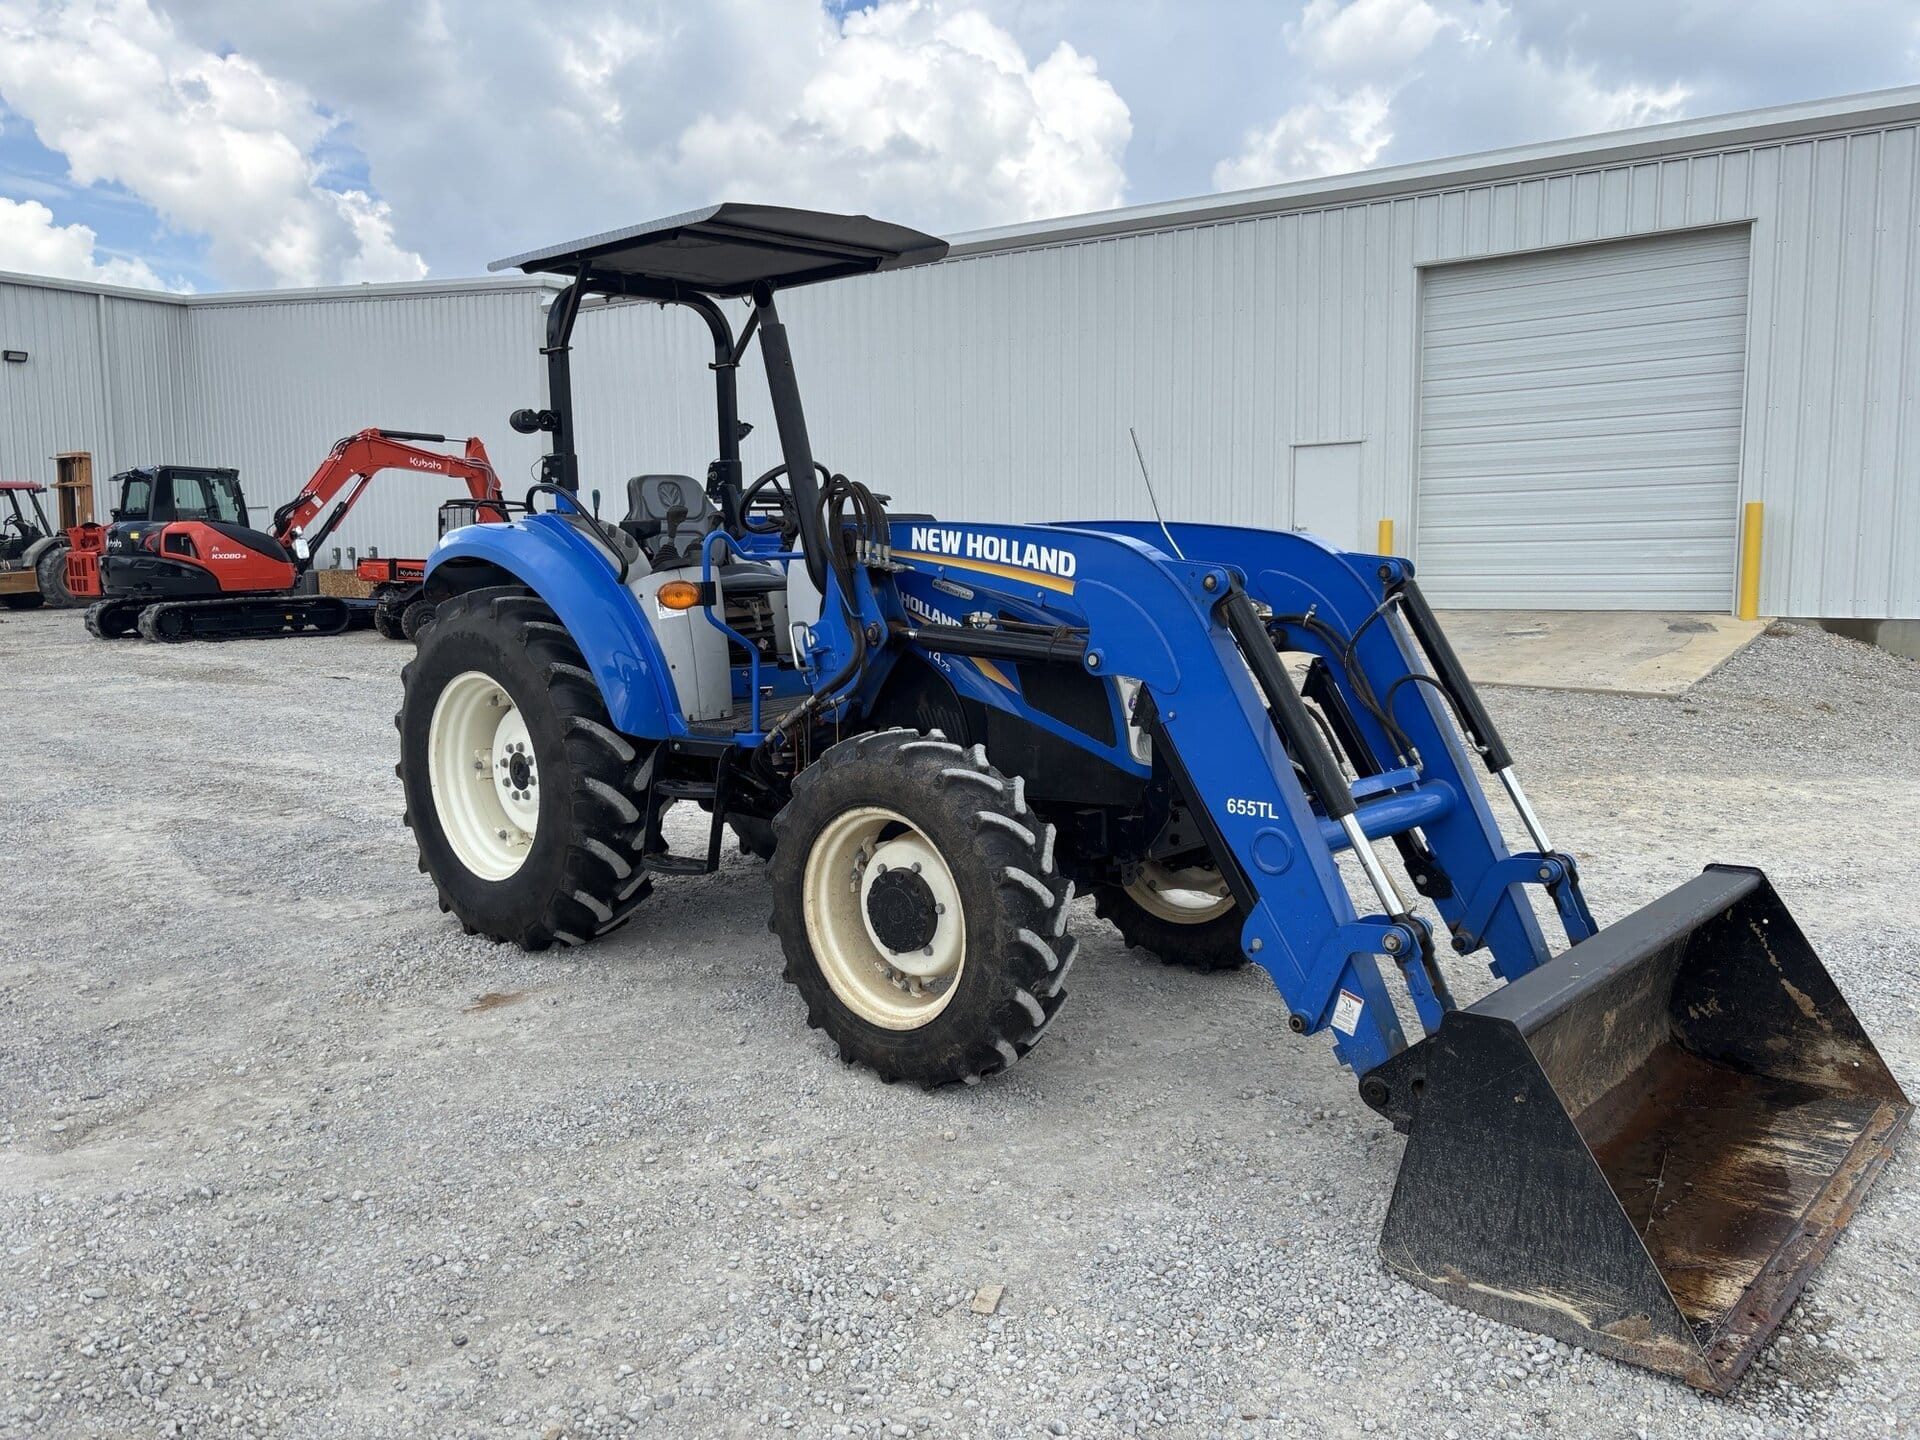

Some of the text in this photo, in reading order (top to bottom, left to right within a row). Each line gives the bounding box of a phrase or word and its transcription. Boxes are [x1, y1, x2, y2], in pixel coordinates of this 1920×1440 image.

[410, 457, 442, 470] Kubota
[911, 527, 1077, 578] NEW HOLLAND
[1226, 798, 1279, 820] 655TL
